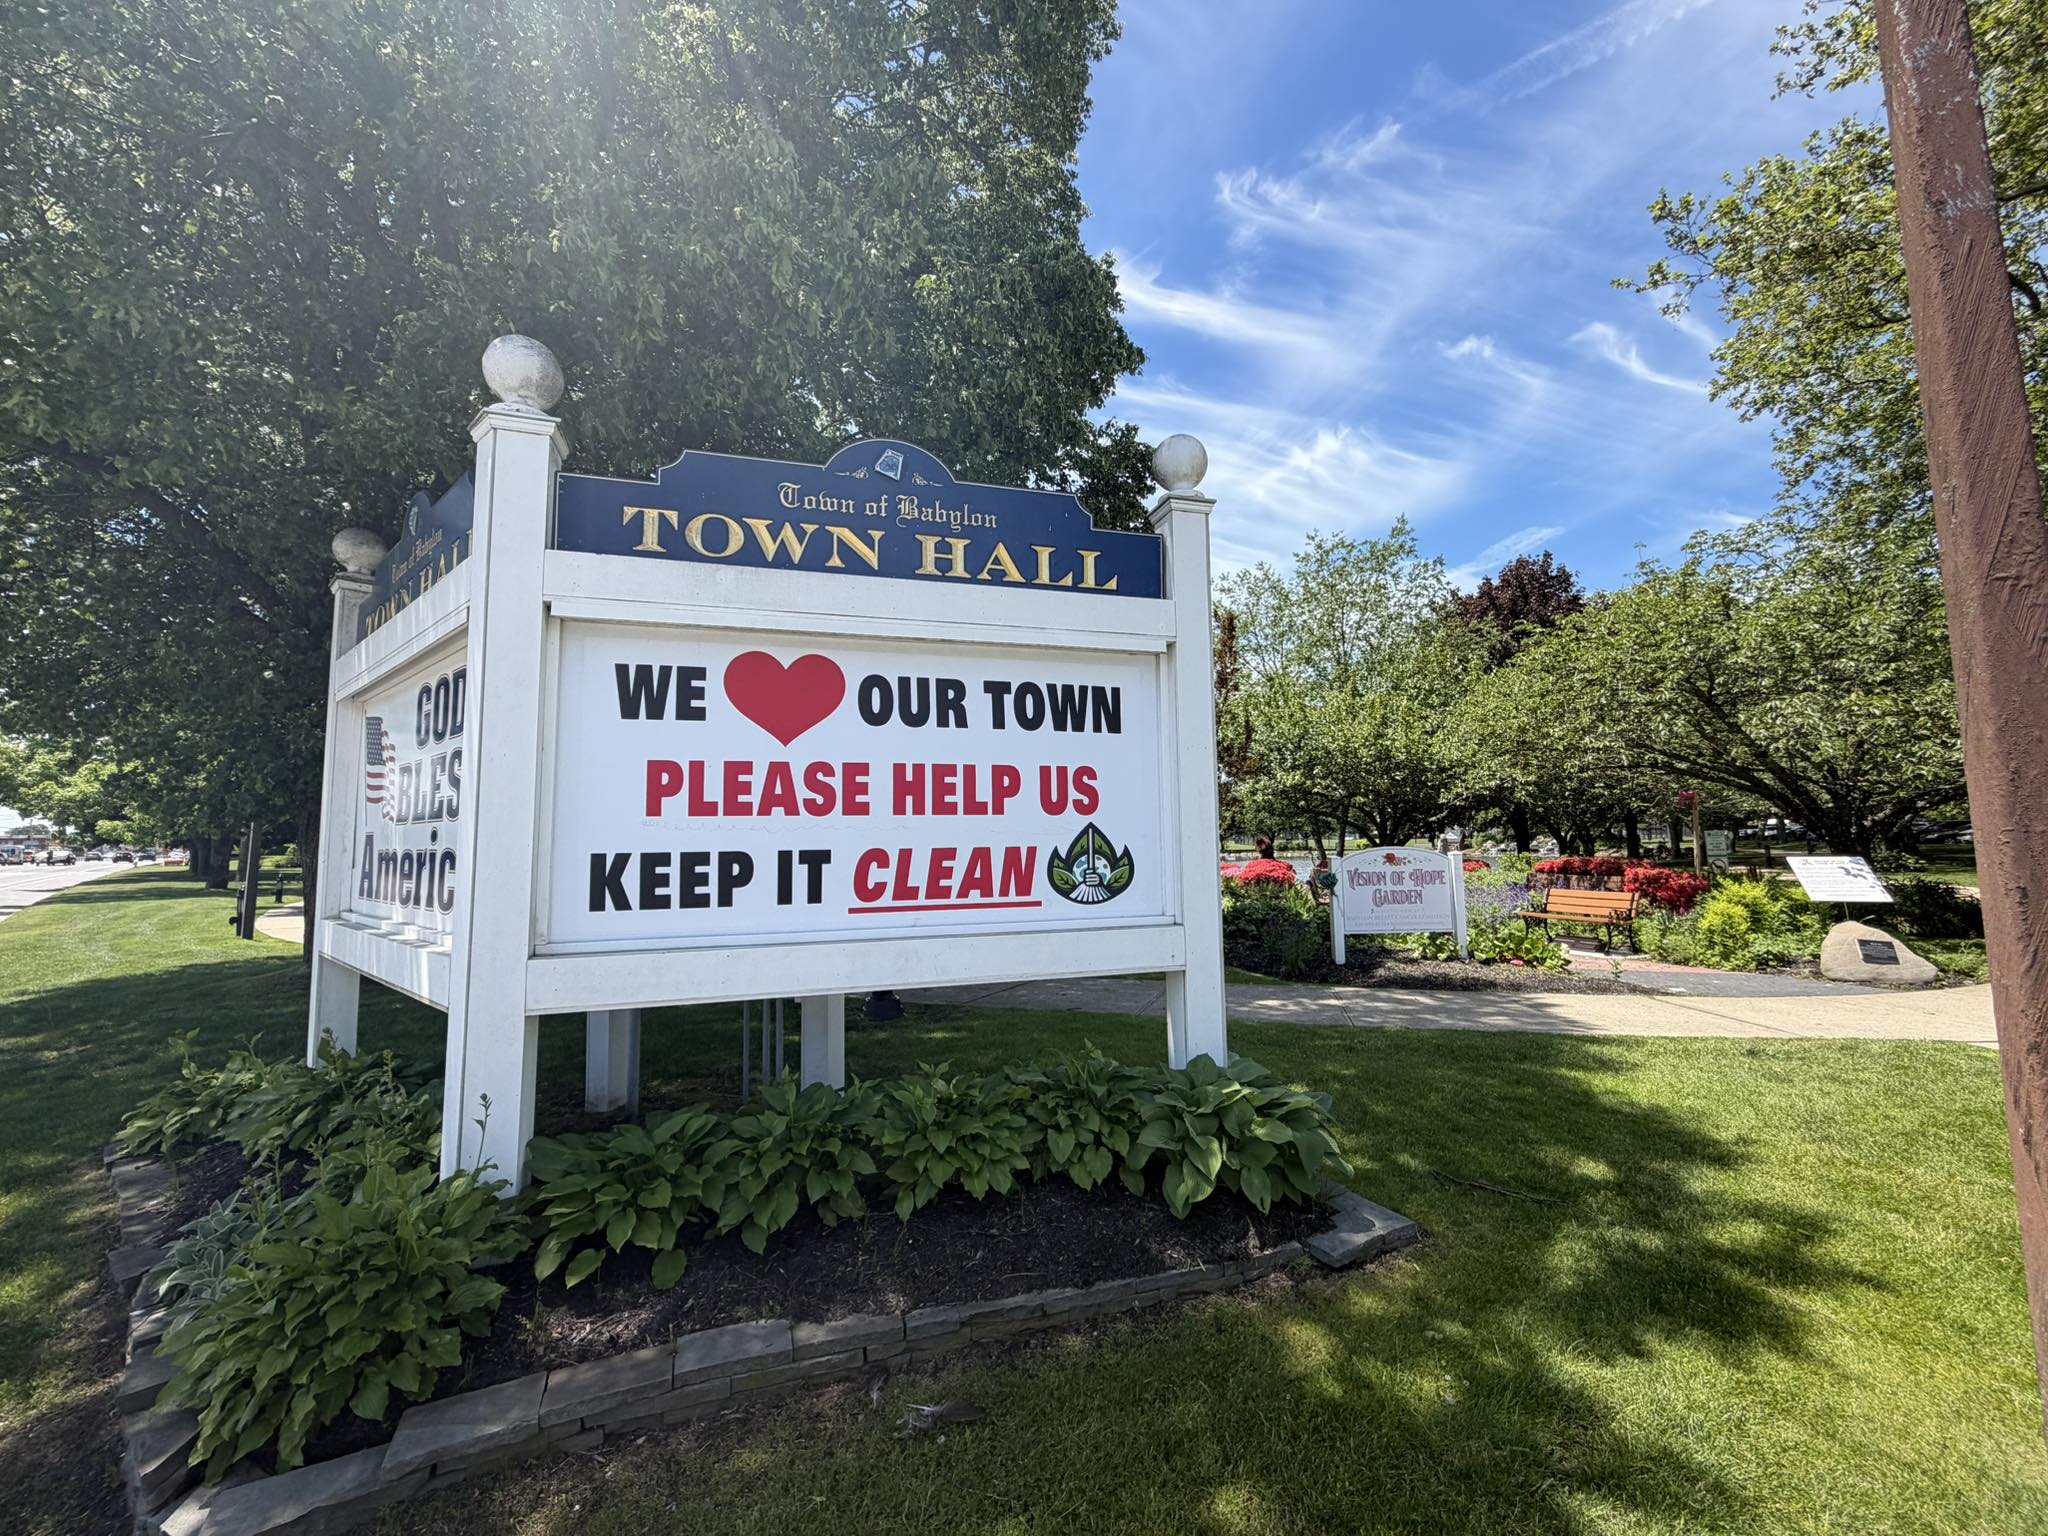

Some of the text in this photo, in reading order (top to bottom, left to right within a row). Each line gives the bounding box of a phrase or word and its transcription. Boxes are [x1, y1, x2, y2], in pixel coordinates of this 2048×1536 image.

[777, 481, 998, 533] Town of Babylon
[623, 506, 1118, 590] TOWN HALL
[614, 663, 1122, 735] WE OUR TOWN
[646, 760, 1100, 817] PLEASE HELP US
[588, 846, 1038, 913] KEEP IT CLEAN
[1346, 867, 1447, 890] VISION OF HOPE
[1371, 888, 1424, 908] GARDEN
